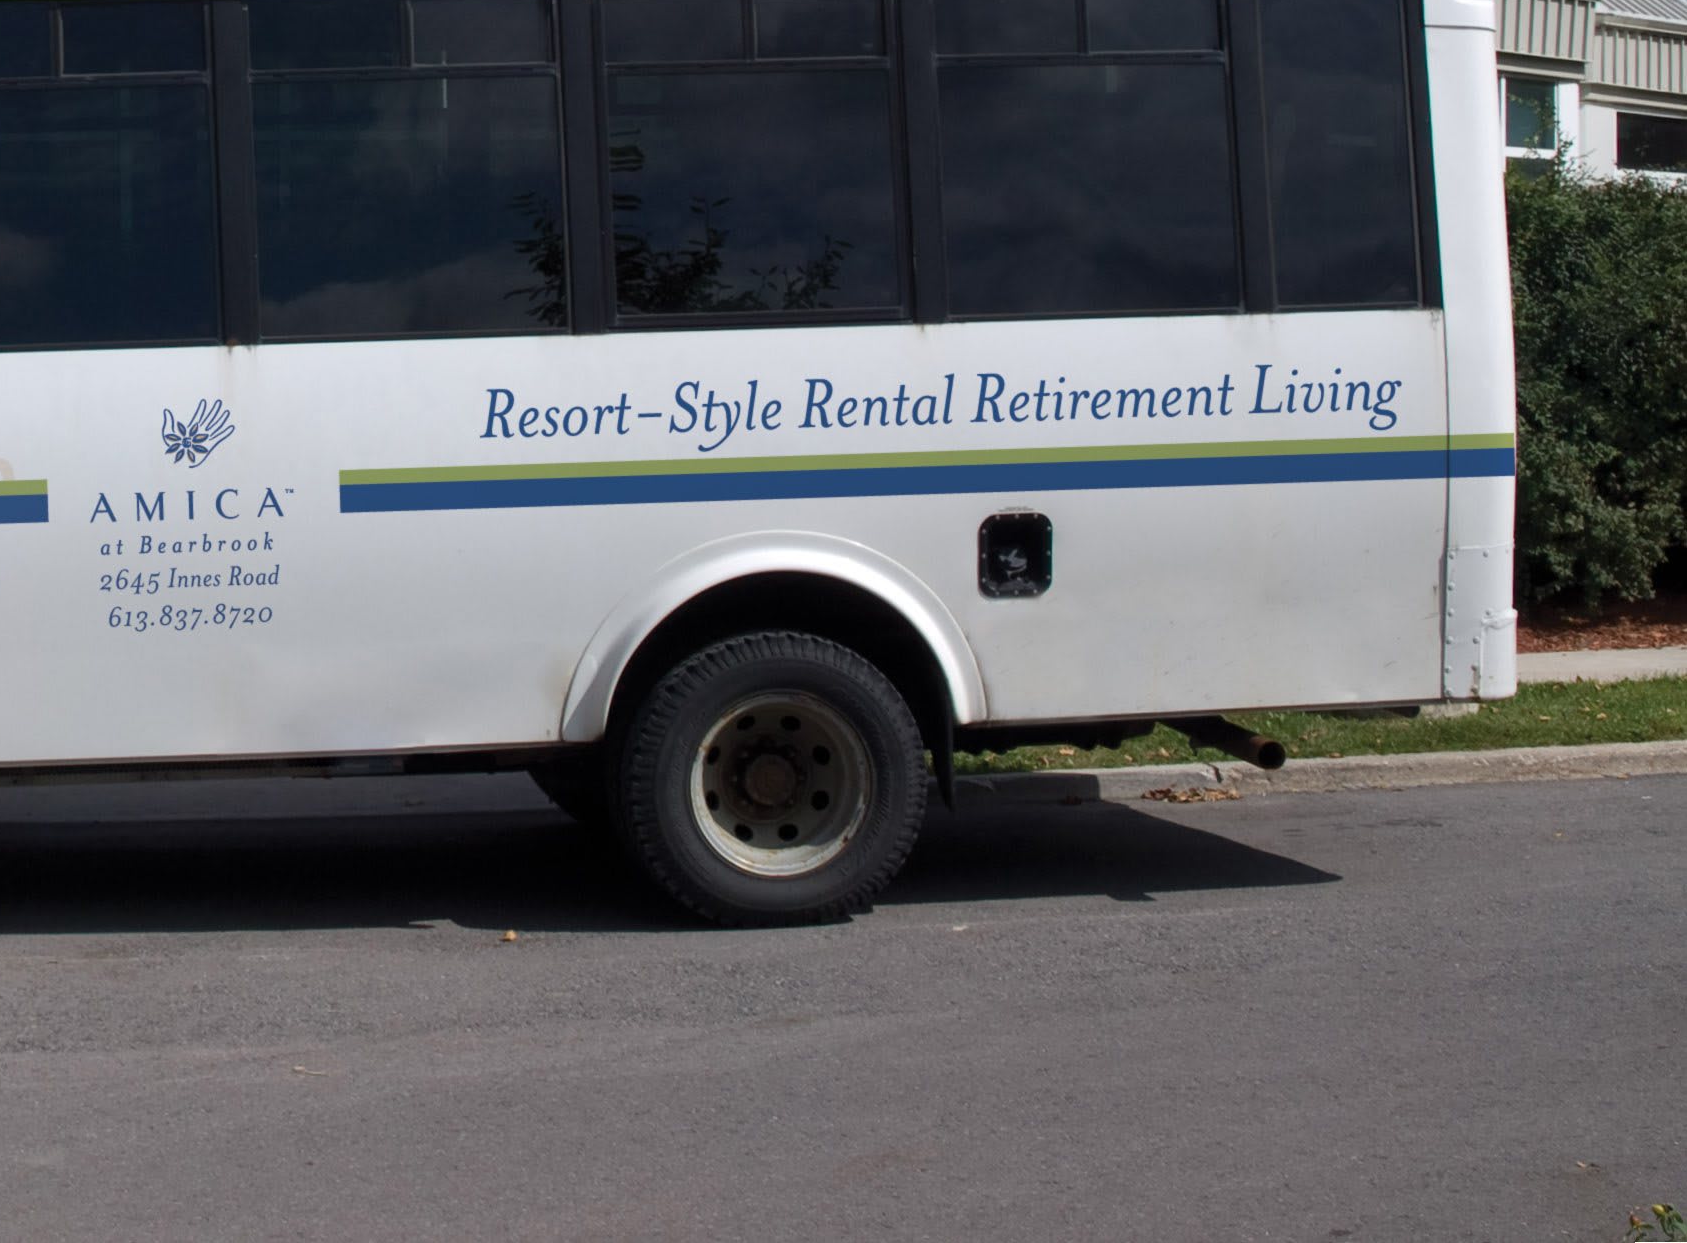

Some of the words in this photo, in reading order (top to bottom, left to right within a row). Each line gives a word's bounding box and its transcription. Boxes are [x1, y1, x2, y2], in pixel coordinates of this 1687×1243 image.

[479, 379, 782, 453] Resort-Style
[798, 373, 955, 429] Rental
[970, 371, 1236, 423] Retirement
[1248, 363, 1404, 432] Living
[100, 536, 124, 556] at
[138, 531, 274, 555] Bearbrook
[100, 568, 161, 595] 2645
[168, 567, 221, 589] Innes
[227, 563, 280, 586] Road
[108, 603, 273, 633] 613.837.8720
